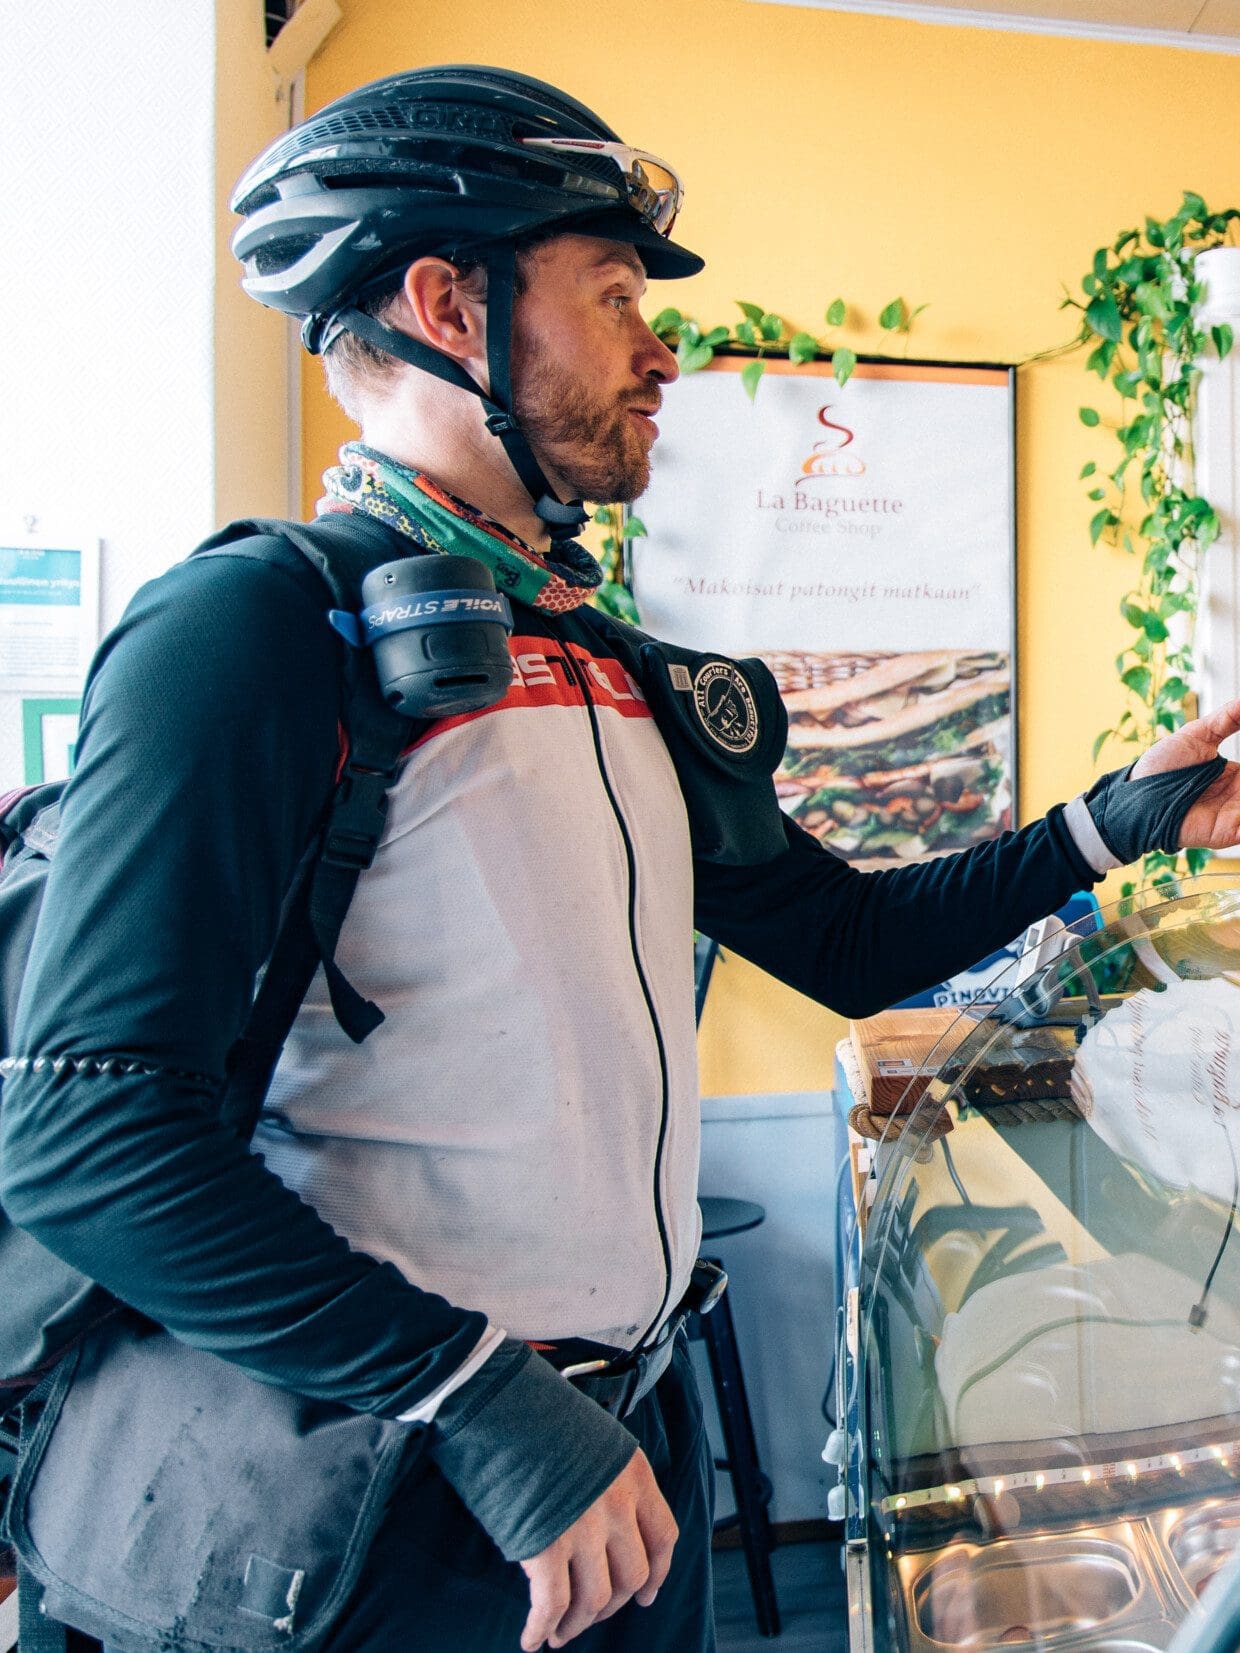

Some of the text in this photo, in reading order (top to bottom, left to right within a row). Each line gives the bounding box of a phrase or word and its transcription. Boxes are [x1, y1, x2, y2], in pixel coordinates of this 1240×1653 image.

[757, 490, 903, 518] La Baguette
[775, 518, 882, 538] Coffee Shop
[368, 600, 440, 630] STRAPS
